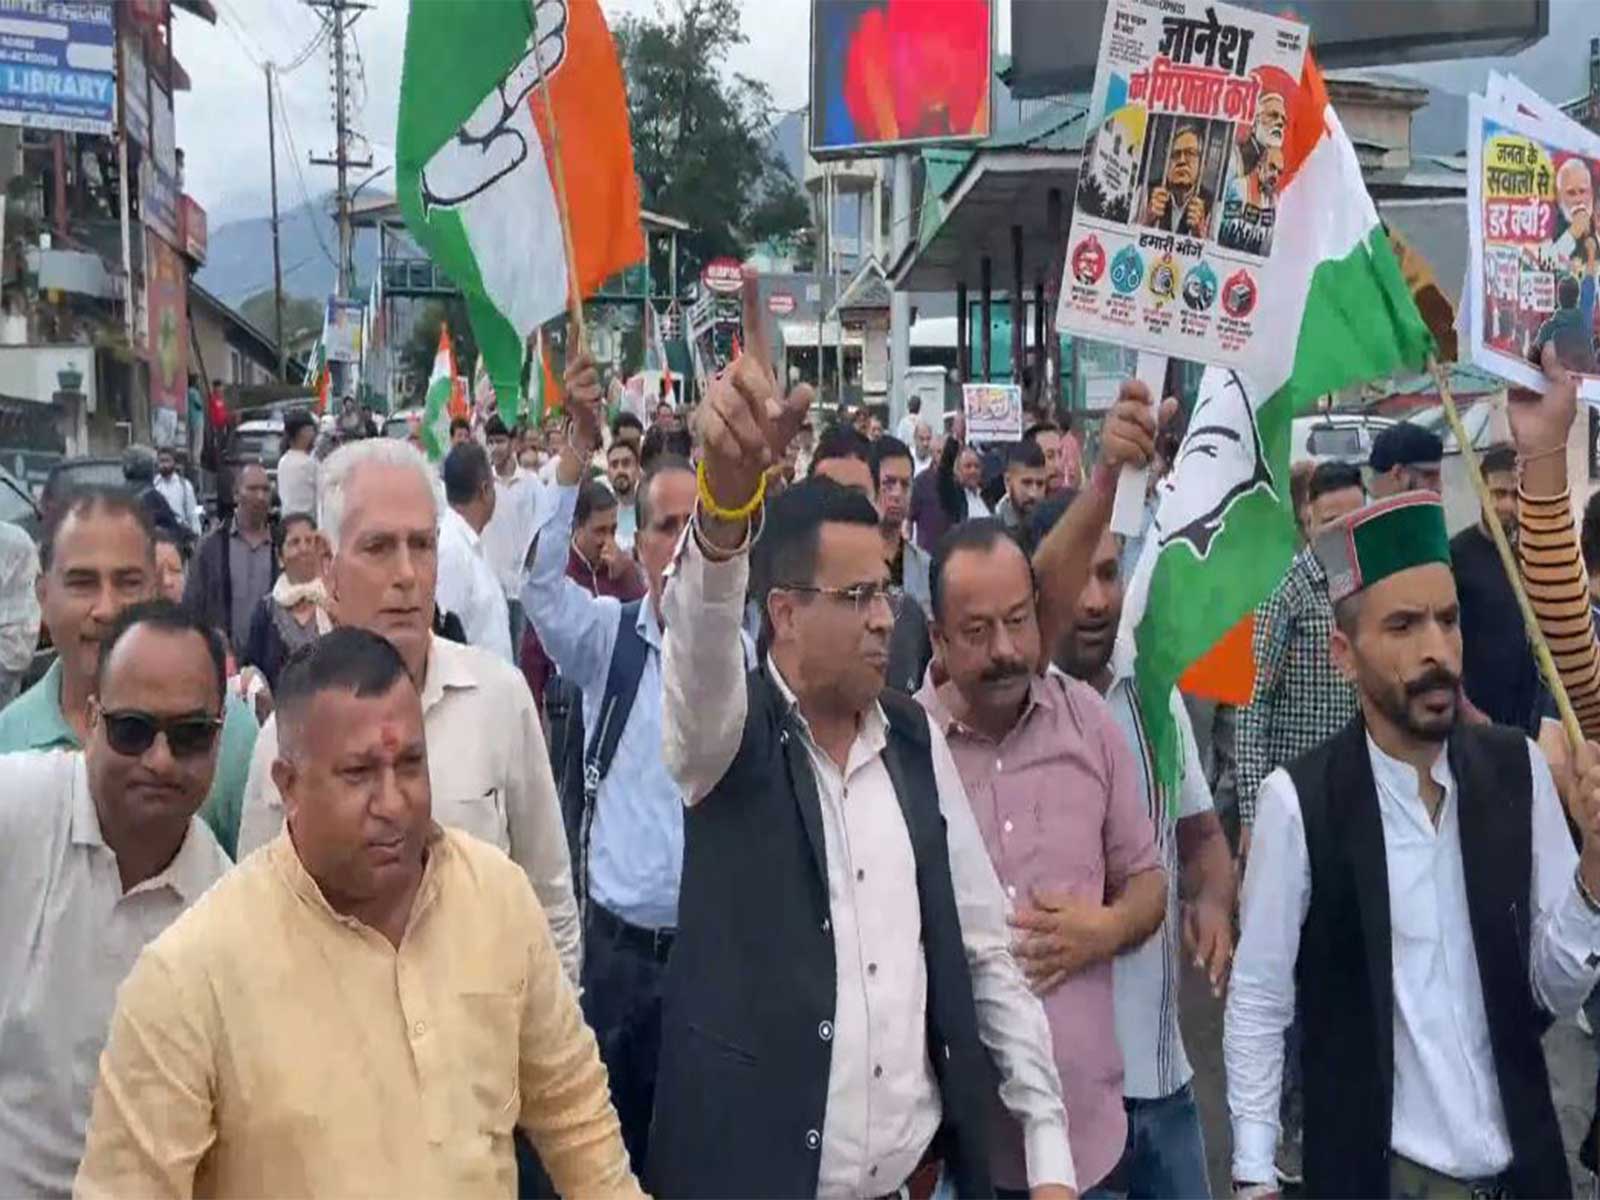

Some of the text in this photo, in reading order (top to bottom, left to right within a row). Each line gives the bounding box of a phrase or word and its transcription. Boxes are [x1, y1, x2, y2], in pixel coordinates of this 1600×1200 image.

[1159, 7, 1254, 77] ज्ञानेश
[8, 66, 109, 102] LIBRARY
[1496, 142, 1538, 165] जनता के
[1537, 164, 1550, 195] से
[1488, 203, 1509, 235] डर
[1139, 232, 1174, 252] हमारी
